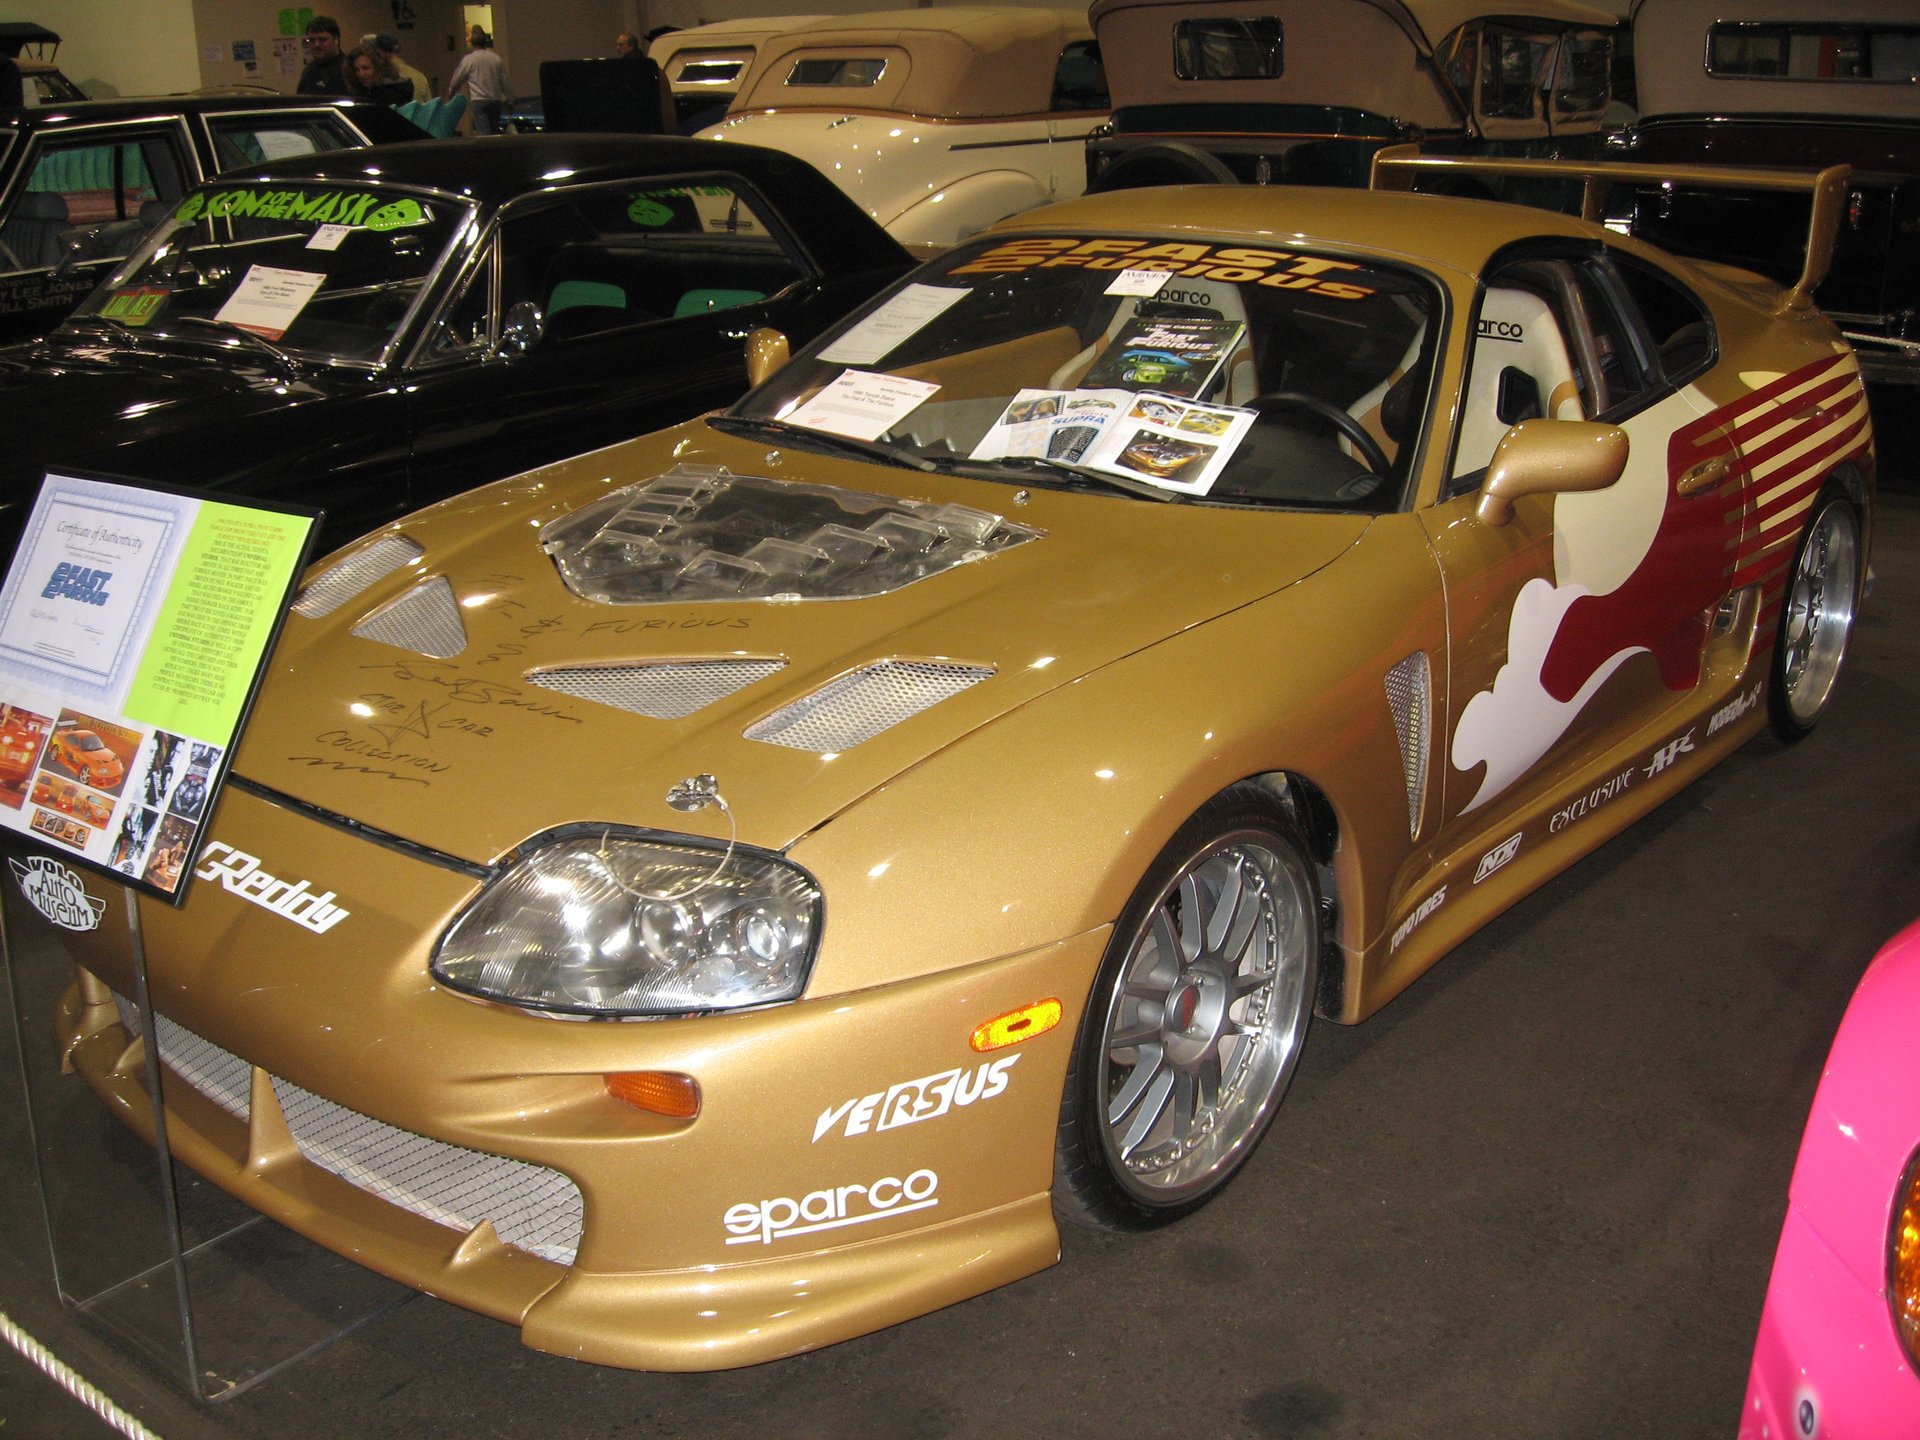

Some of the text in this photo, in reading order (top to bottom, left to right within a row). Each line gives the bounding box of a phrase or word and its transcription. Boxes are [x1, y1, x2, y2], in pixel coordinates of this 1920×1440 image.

[199, 191, 269, 219] SON
[269, 192, 299, 205] OF
[284, 192, 378, 225] MASK
[28, 294, 74, 310] SMITH
[45, 279, 94, 295] JONES
[1158, 288, 1212, 306] parco
[1477, 319, 1523, 342] arco
[1052, 415, 1106, 425] SUPRA
[57, 520, 92, 541] Certificate
[99, 528, 144, 554] Authenticity
[580, 612, 753, 638] FURIOUS
[437, 718, 495, 738] CAR
[315, 730, 453, 773] COLLECTION
[1549, 766, 1636, 833] EXCLUSIVE
[29, 859, 83, 893] VOLO
[40, 871, 77, 907] Auto
[811, 1052, 1022, 1144] VERSUS
[723, 1168, 939, 1245] sparco
